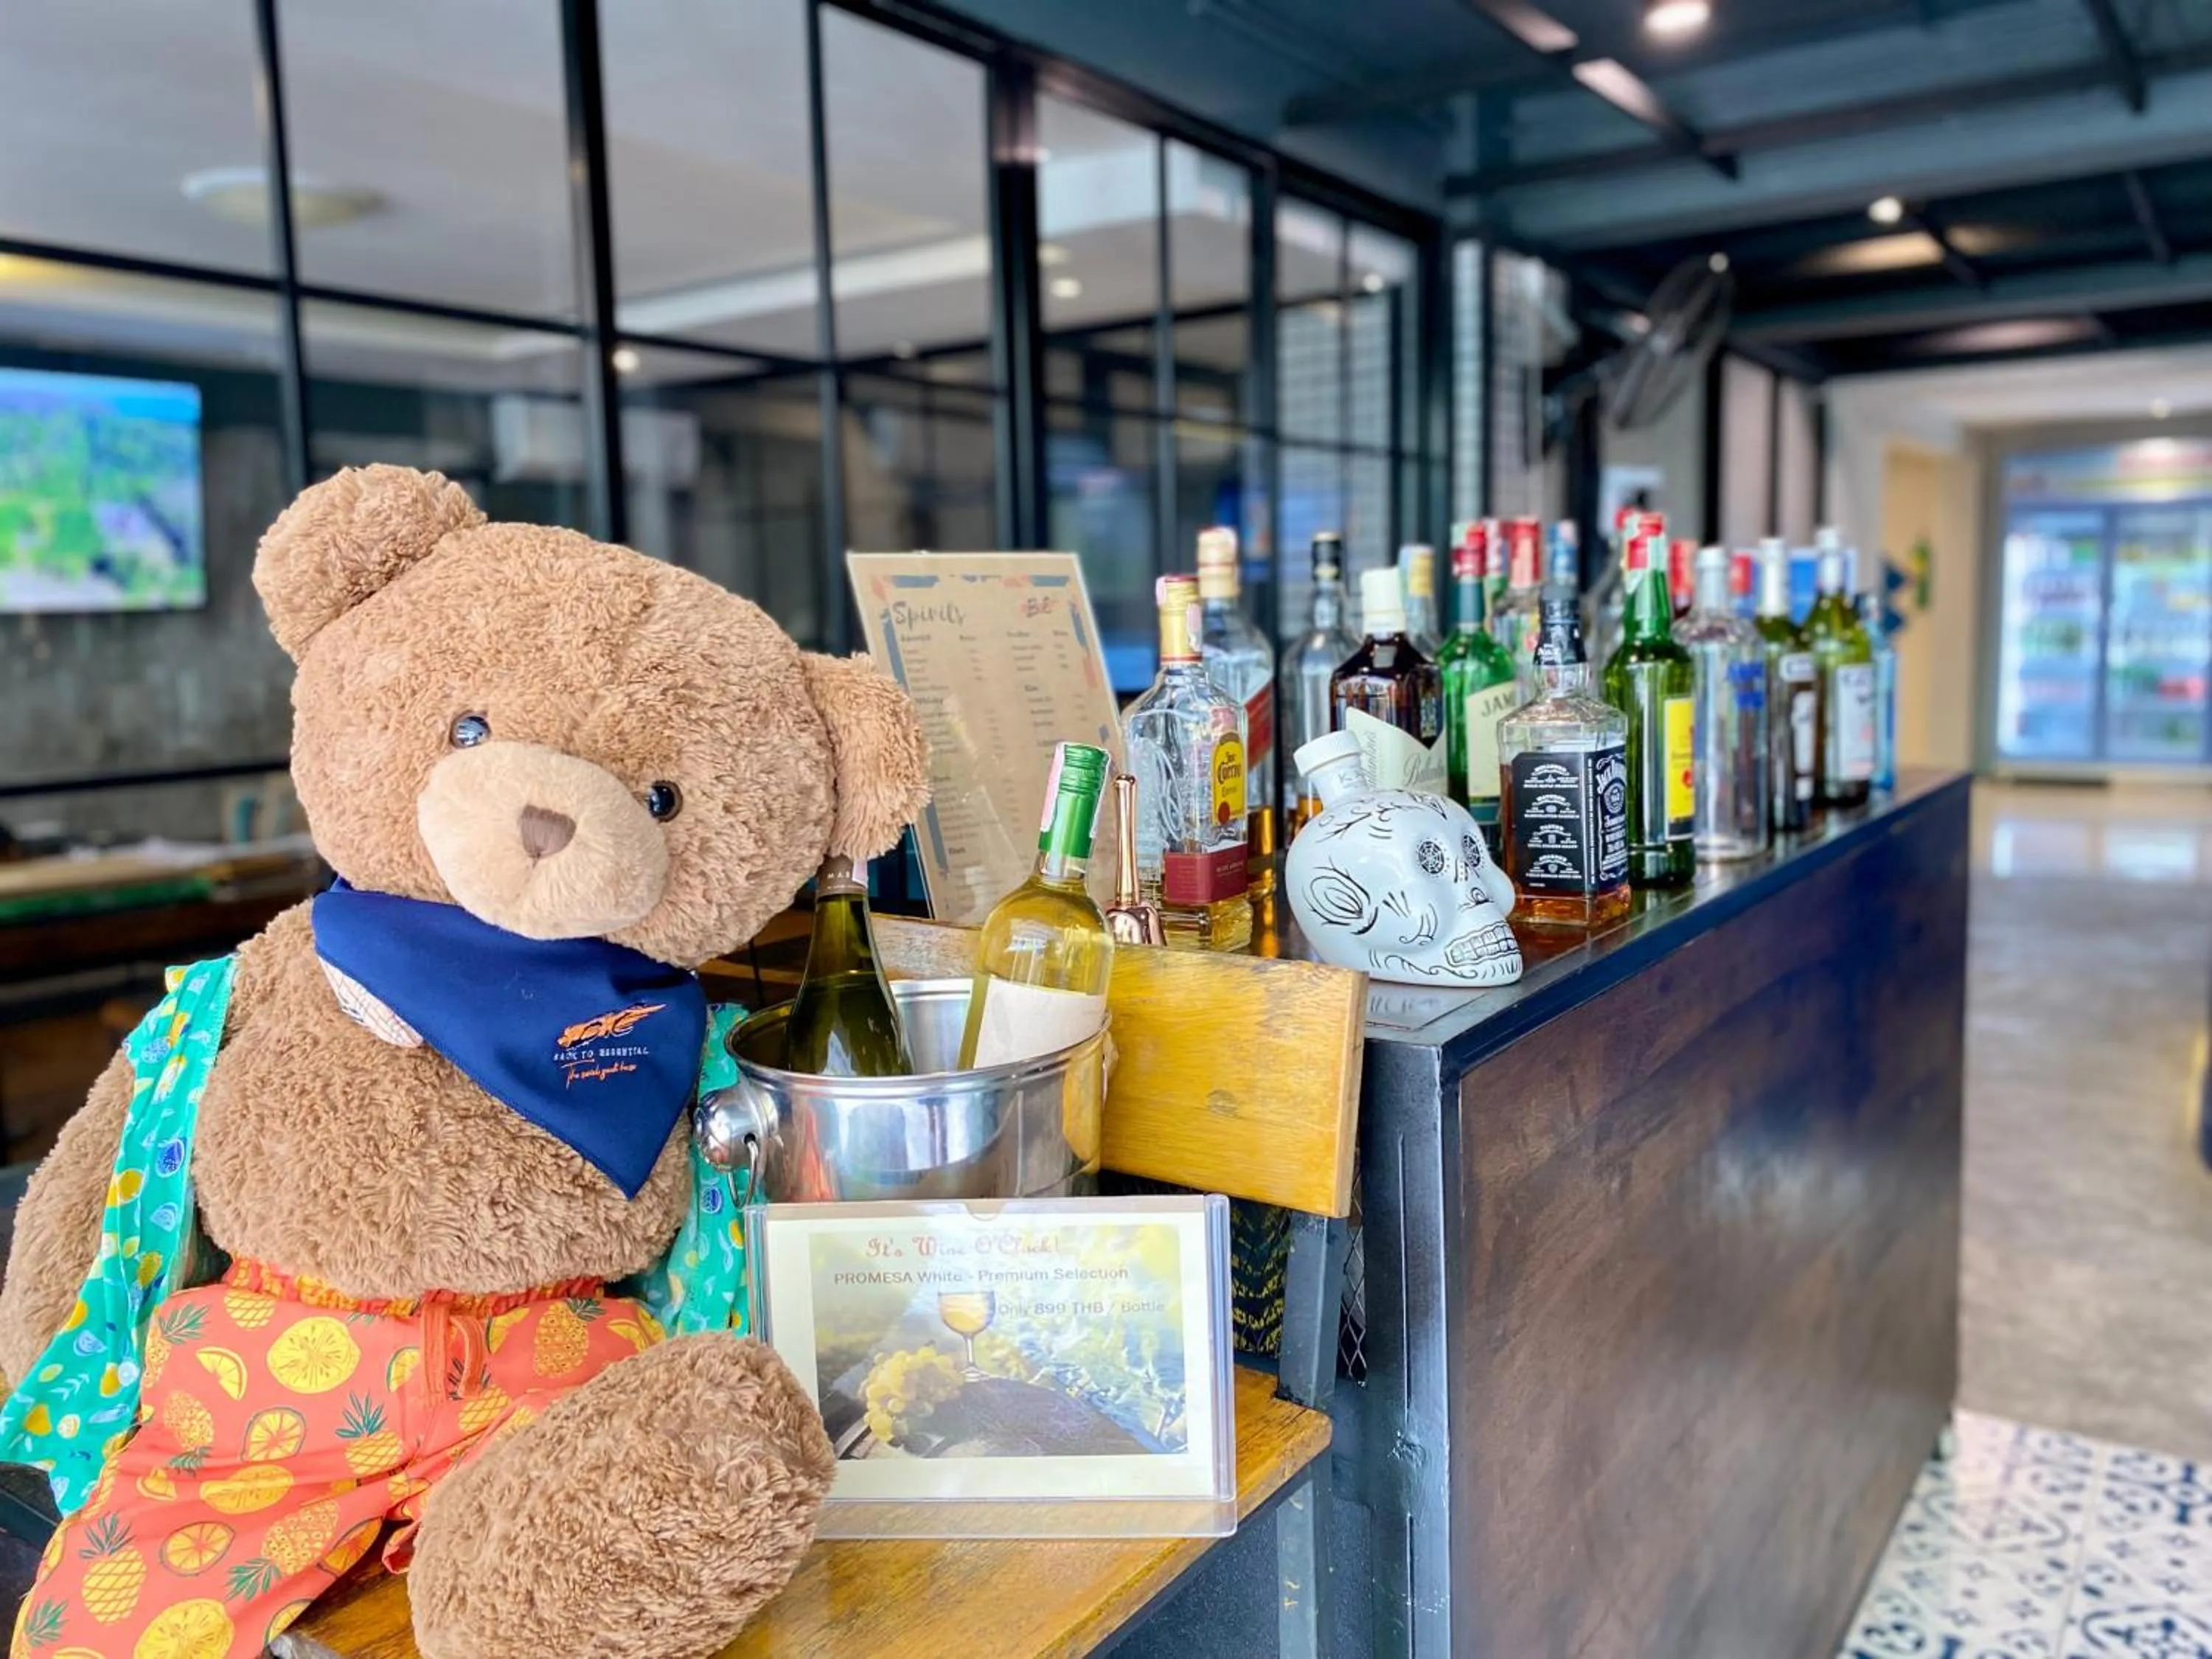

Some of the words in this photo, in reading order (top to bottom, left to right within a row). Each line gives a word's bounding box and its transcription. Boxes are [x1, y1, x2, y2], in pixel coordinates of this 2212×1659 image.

[581, 1049, 594, 1060] TO
[834, 1271, 913, 1284] PROMESA
[917, 1270, 963, 1283] White
[978, 1268, 1048, 1283] Premium
[1053, 1267, 1129, 1281] Selection
[998, 1298, 1029, 1316] Only
[1034, 1302, 1066, 1315] 899
[1072, 1301, 1105, 1315] THB
